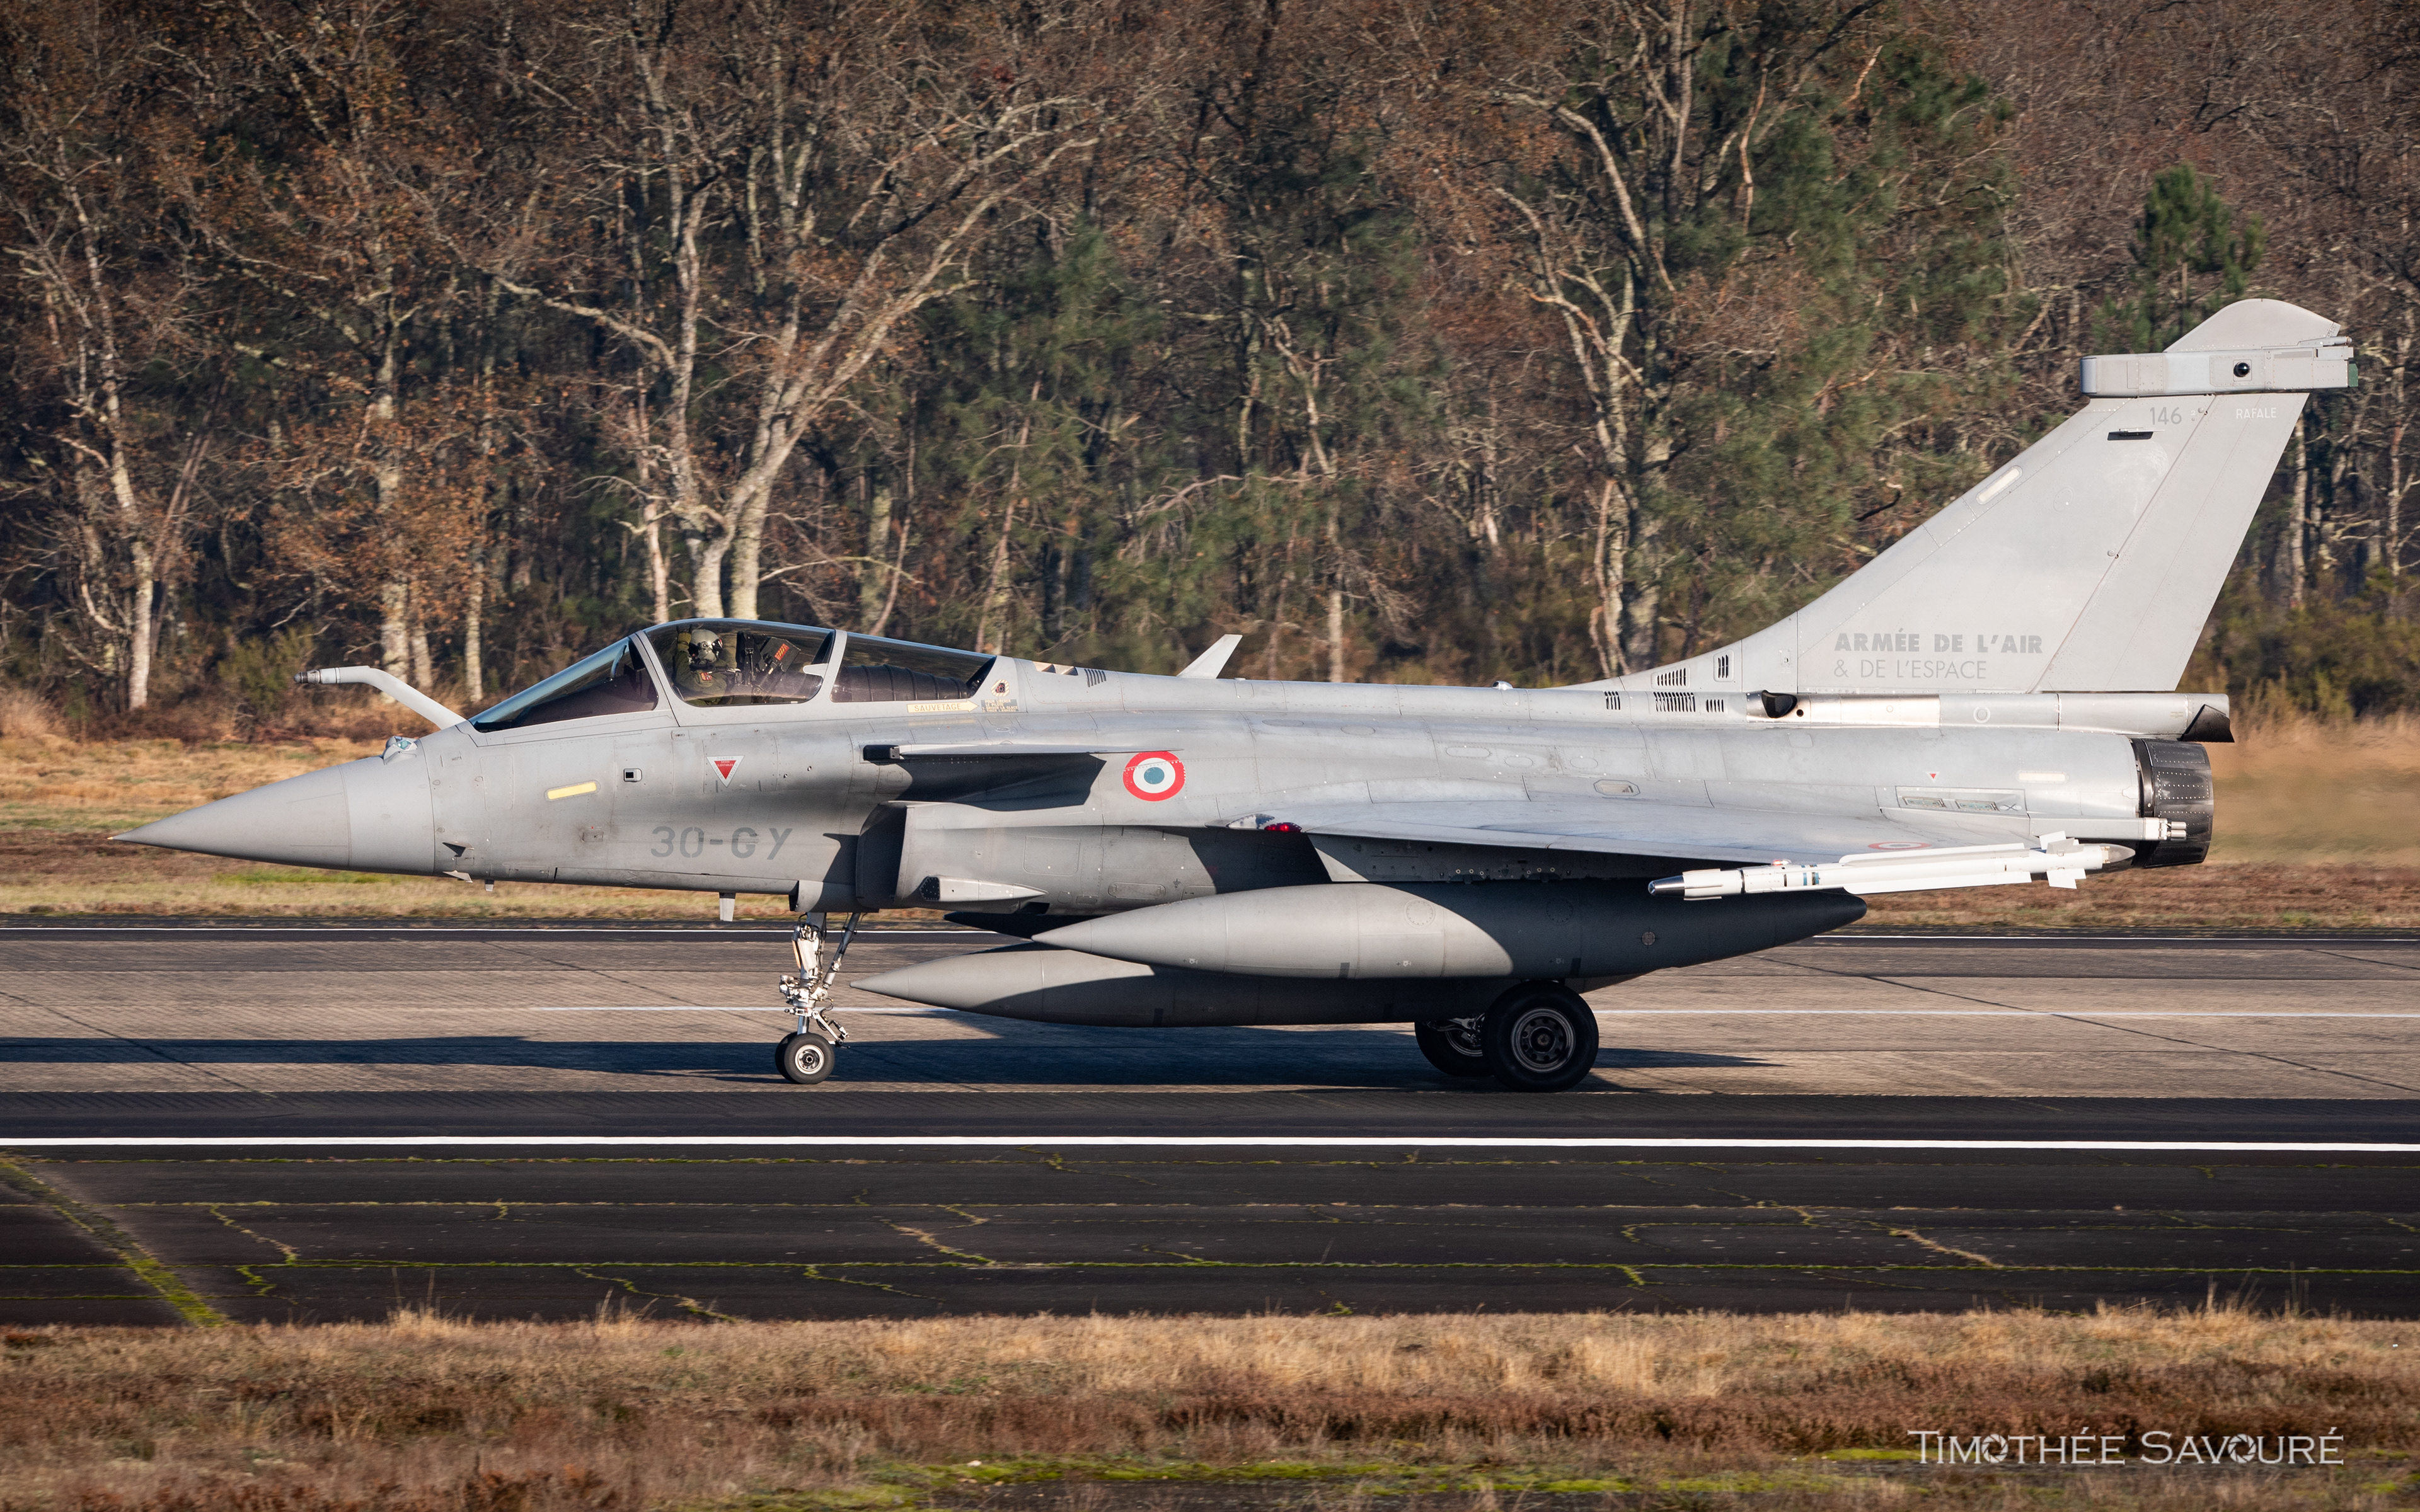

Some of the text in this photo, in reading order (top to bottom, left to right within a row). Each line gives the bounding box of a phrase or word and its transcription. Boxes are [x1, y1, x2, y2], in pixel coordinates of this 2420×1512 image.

[2150, 406, 2182, 425] 146
[2236, 408, 2277, 419] RAFALE
[1834, 627, 2043, 653] ARMÉE DE L'AIR
[1833, 660, 1986, 679] & DE L'ESPACE
[914, 703, 962, 712] SAUVETAGE
[729, 763, 738, 779] DANGER
[650, 826, 793, 860] 30-GY
